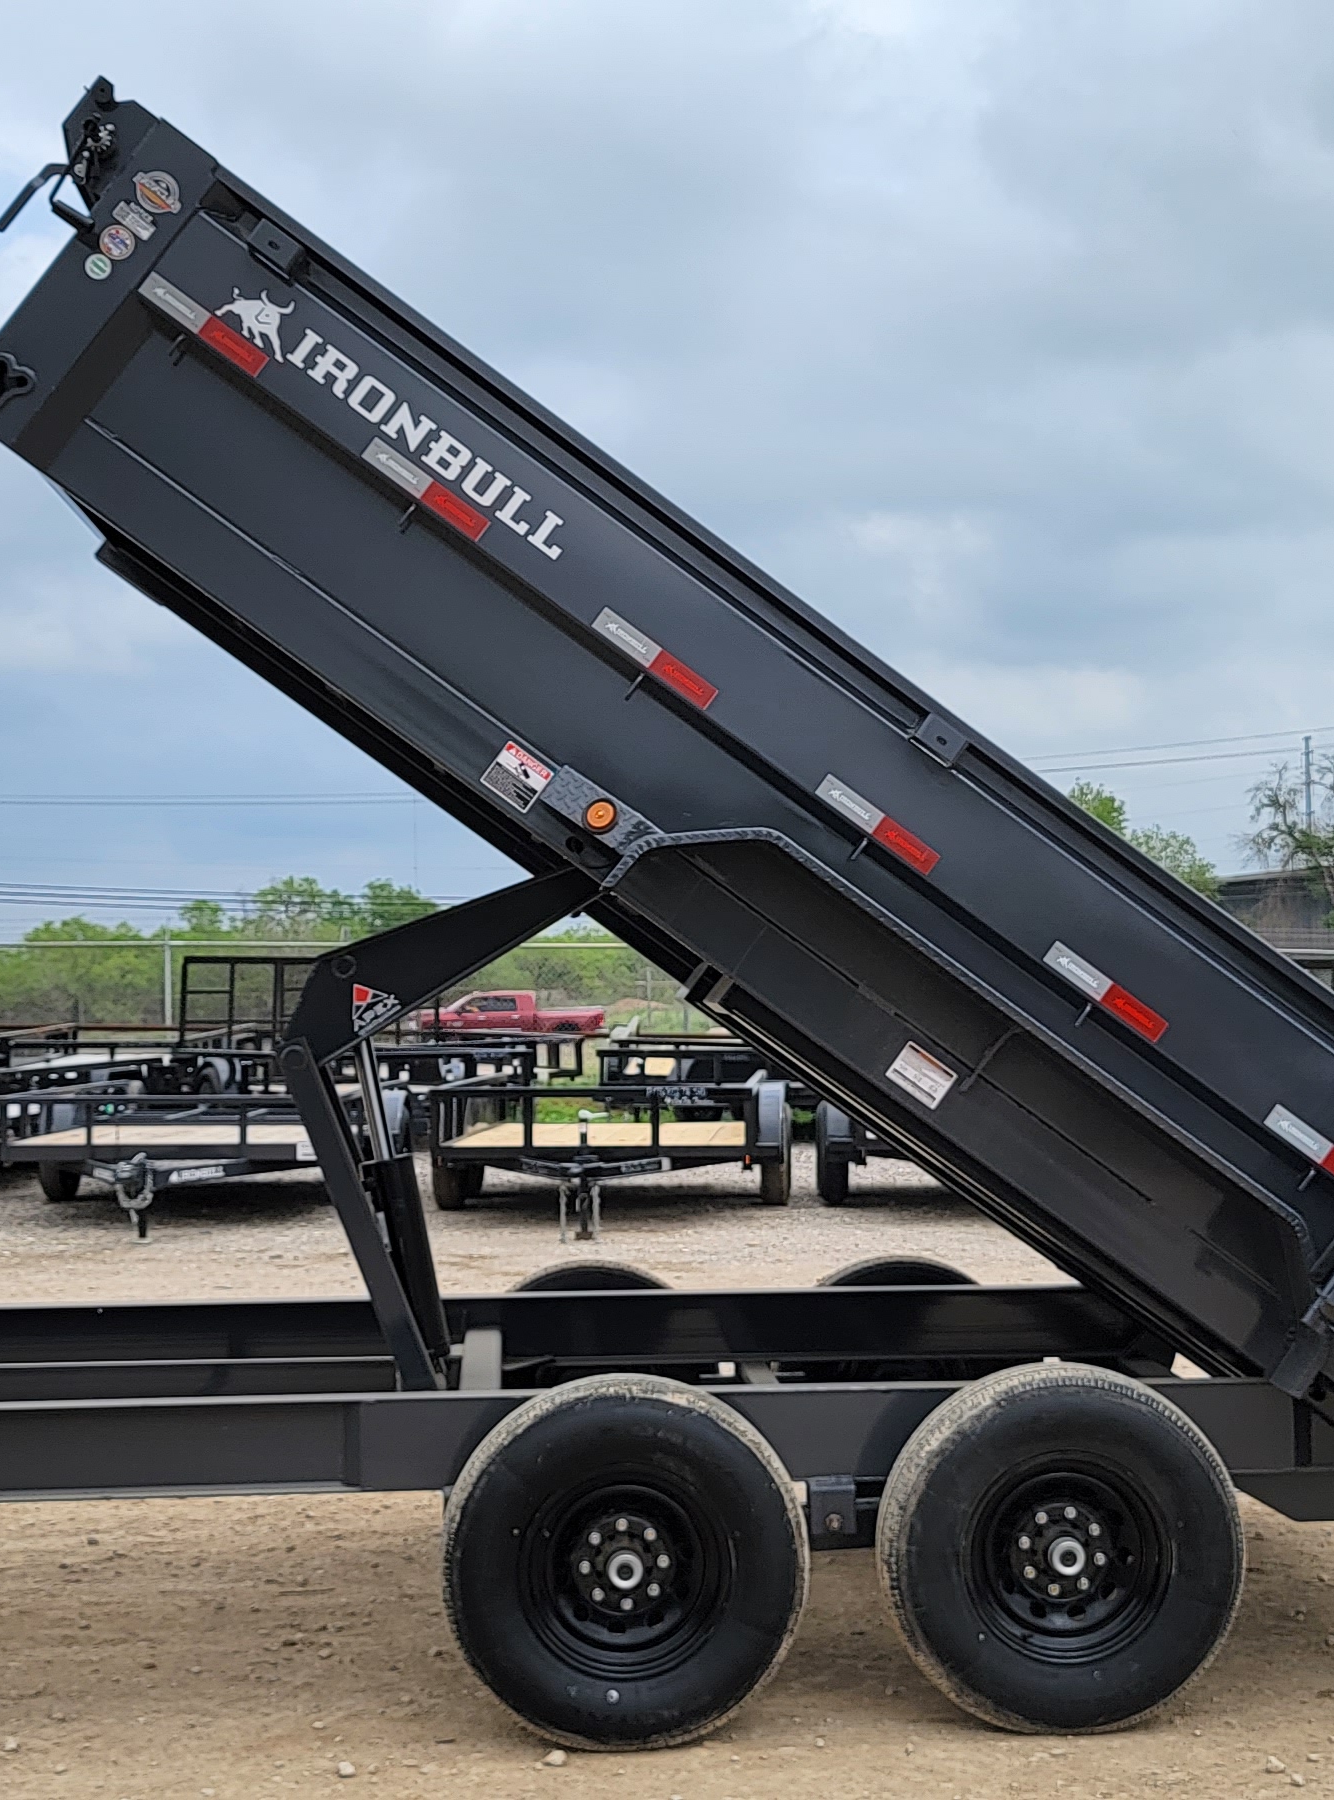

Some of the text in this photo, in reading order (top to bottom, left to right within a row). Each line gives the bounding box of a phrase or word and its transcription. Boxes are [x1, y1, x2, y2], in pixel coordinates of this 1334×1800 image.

[285, 327, 564, 560] IRONBULL
[515, 750, 548, 778] DANGER
[354, 994, 400, 1032] APEX
